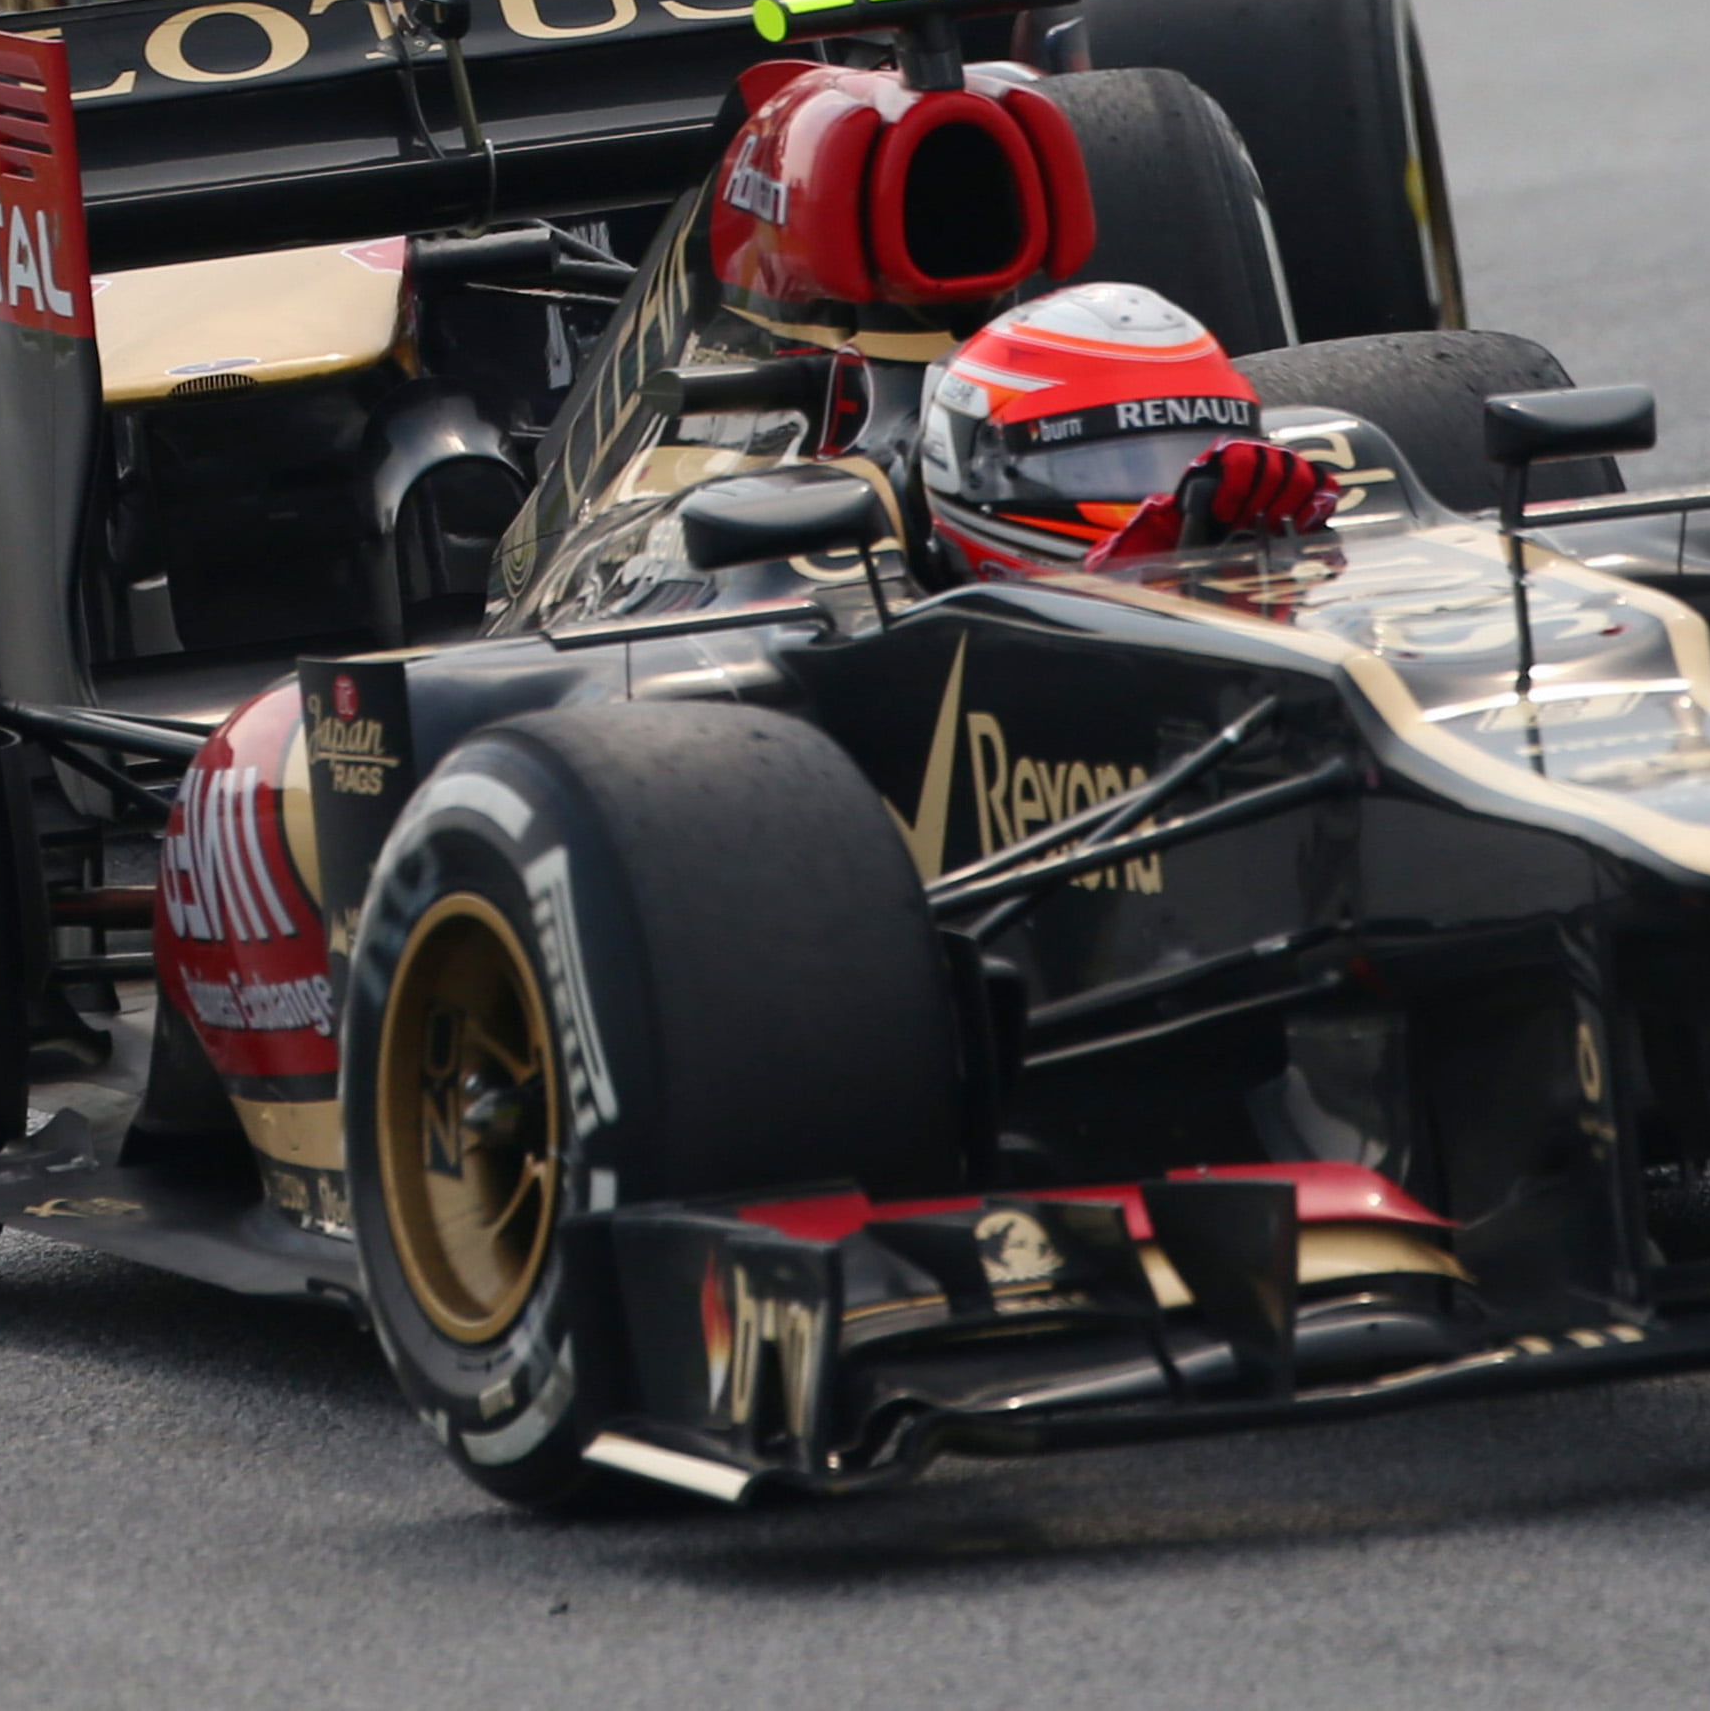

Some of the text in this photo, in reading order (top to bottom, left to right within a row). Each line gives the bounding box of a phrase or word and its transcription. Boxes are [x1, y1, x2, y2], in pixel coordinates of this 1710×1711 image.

[1115, 398, 1252, 430] RENAULT
[307, 695, 386, 765] Japan
[331, 763, 385, 795] RAGS
